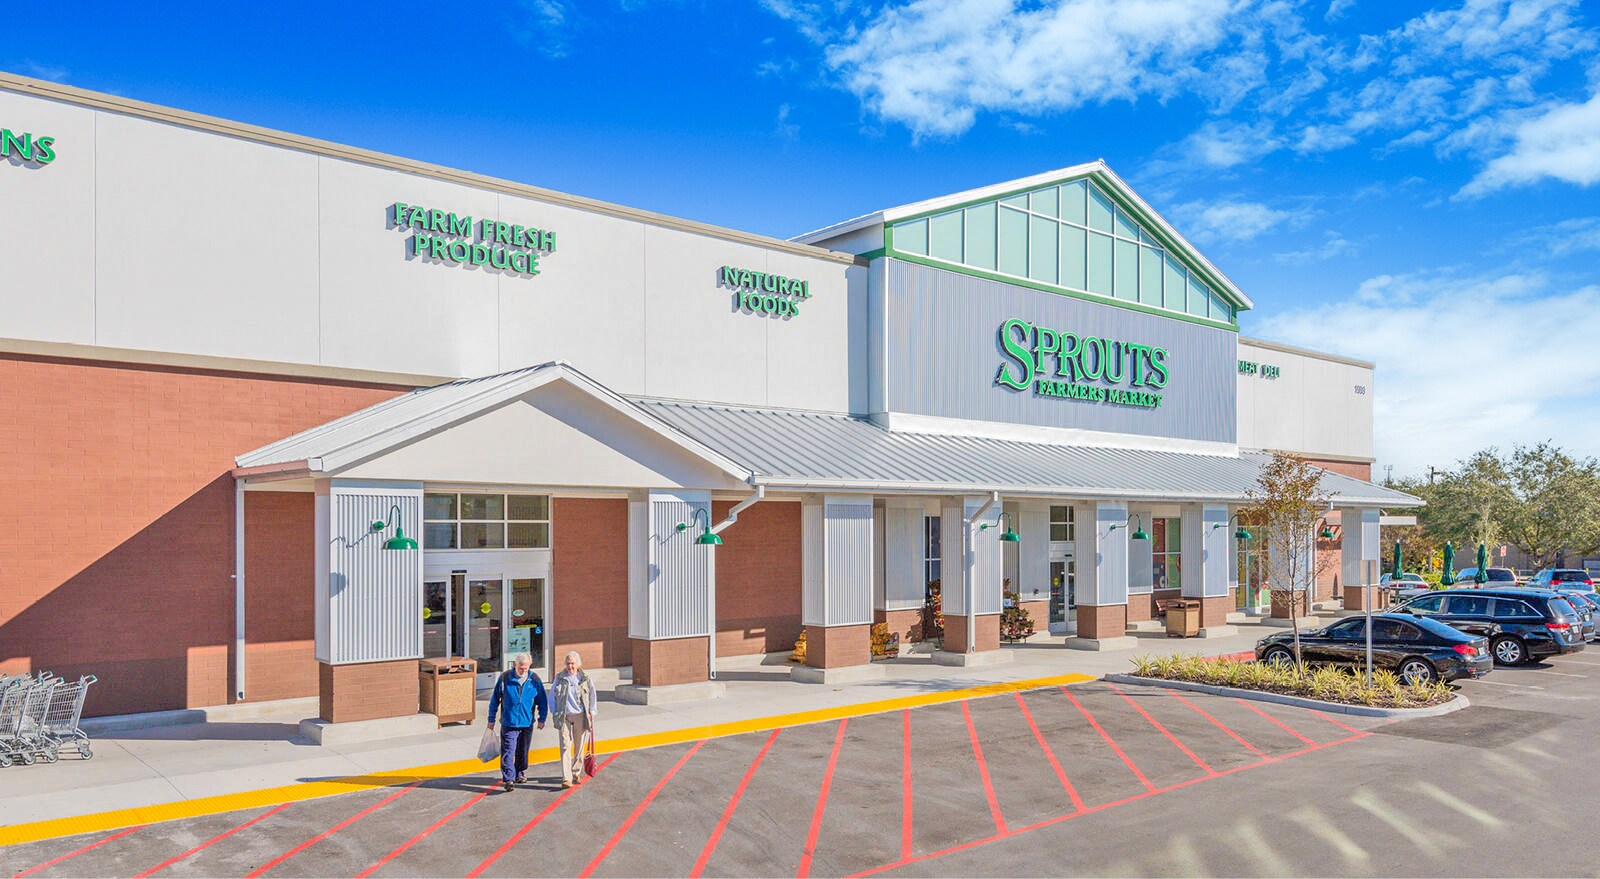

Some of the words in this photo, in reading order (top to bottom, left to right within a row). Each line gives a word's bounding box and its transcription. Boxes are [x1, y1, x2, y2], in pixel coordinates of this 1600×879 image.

[394, 202, 473, 238] FARM
[481, 219, 557, 252] FRESH
[414, 233, 541, 275] PRODUCE
[722, 265, 813, 298] NATURAL
[738, 290, 799, 316] FOODS
[998, 317, 1169, 390] SPROUTS
[1237, 360, 1259, 375] MEAT
[1037, 379, 1105, 402] FARMERS
[1108, 390, 1163, 408] MARKET
